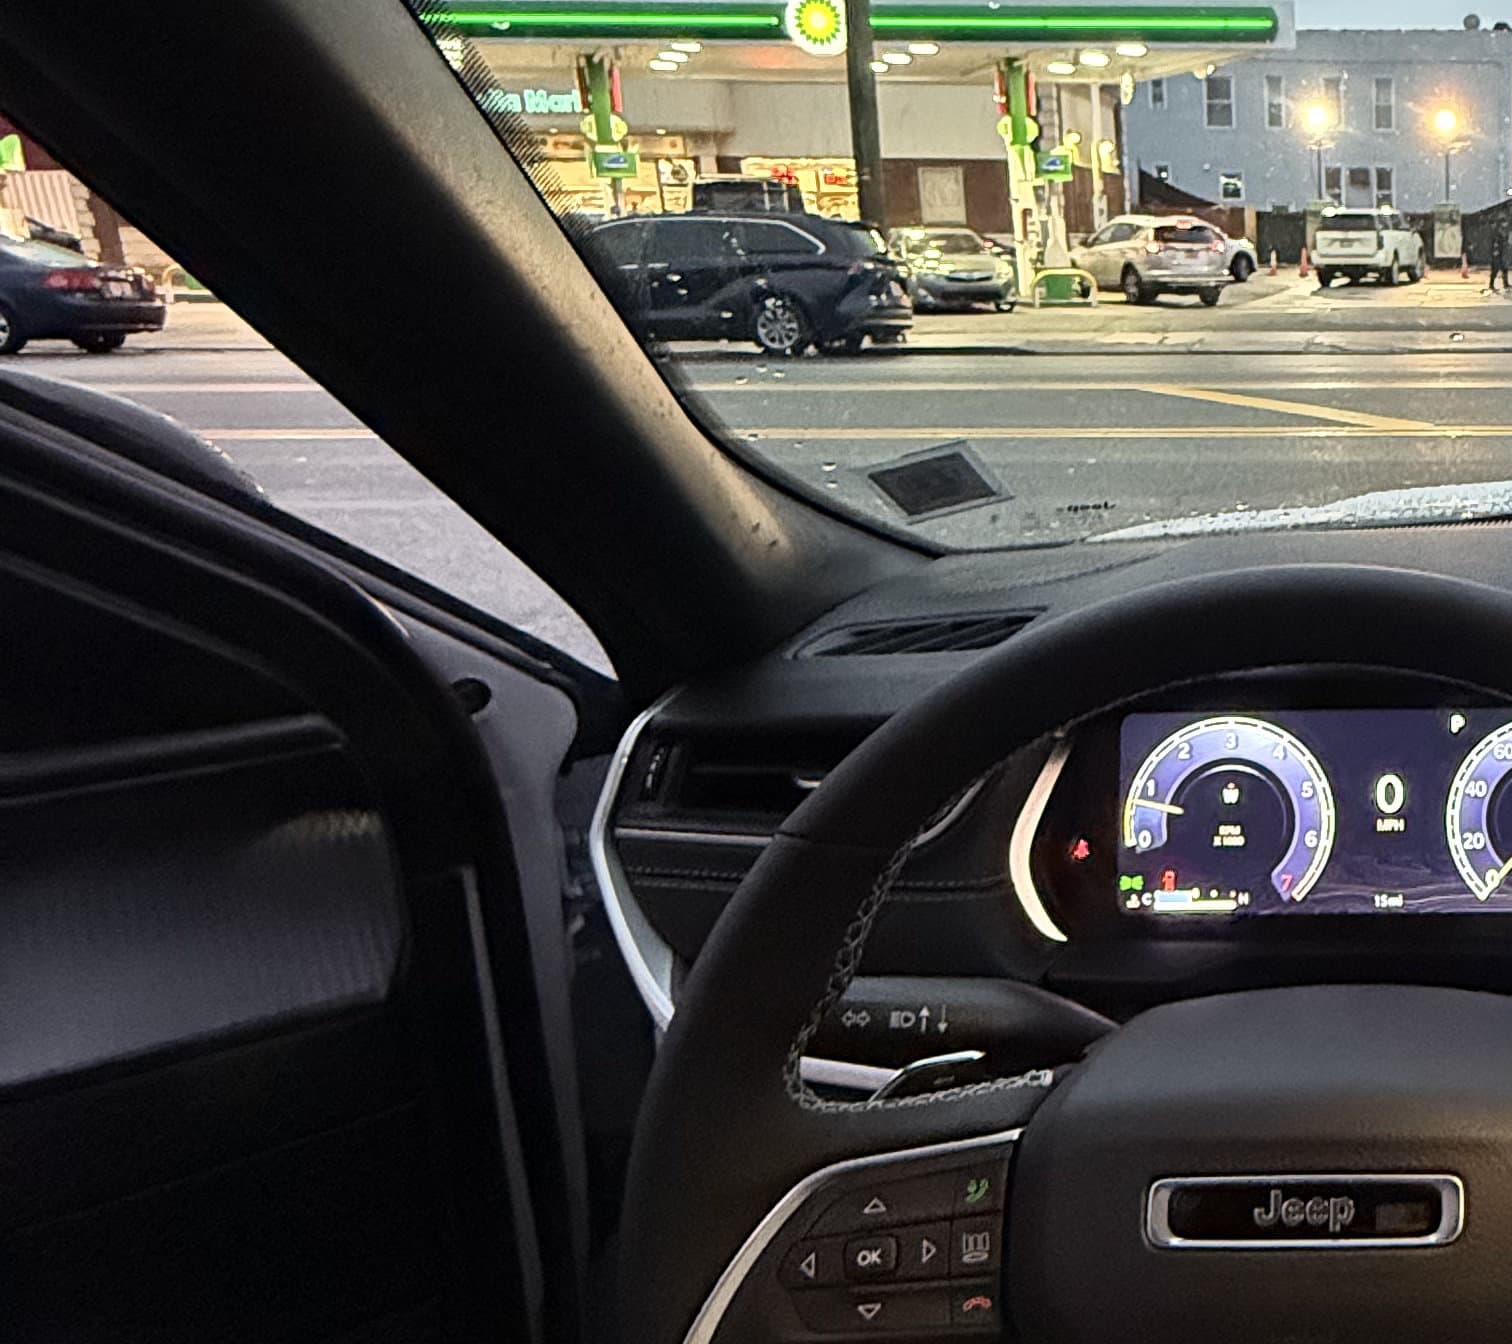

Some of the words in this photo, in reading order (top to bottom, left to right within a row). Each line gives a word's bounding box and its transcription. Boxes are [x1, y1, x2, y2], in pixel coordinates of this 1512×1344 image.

[1225, 732, 1238, 750] 3
[1177, 743, 1193, 760] 2
[1273, 742, 1288, 761] 4
[1147, 779, 1156, 797] 1
[1300, 781, 1313, 798] 5
[1375, 773, 1405, 814] 0
[1465, 781, 1488, 798] 40
[1376, 819, 1405, 832] MPH
[1138, 830, 1153, 849] 0
[1304, 830, 1319, 849] 6
[1463, 833, 1485, 850] 20
[1280, 874, 1293, 892] 7
[1485, 869, 1499, 886] 0
[1141, 894, 1153, 906] C
[1254, 1189, 1355, 1233] Jeep
[857, 1248, 883, 1267] OK
